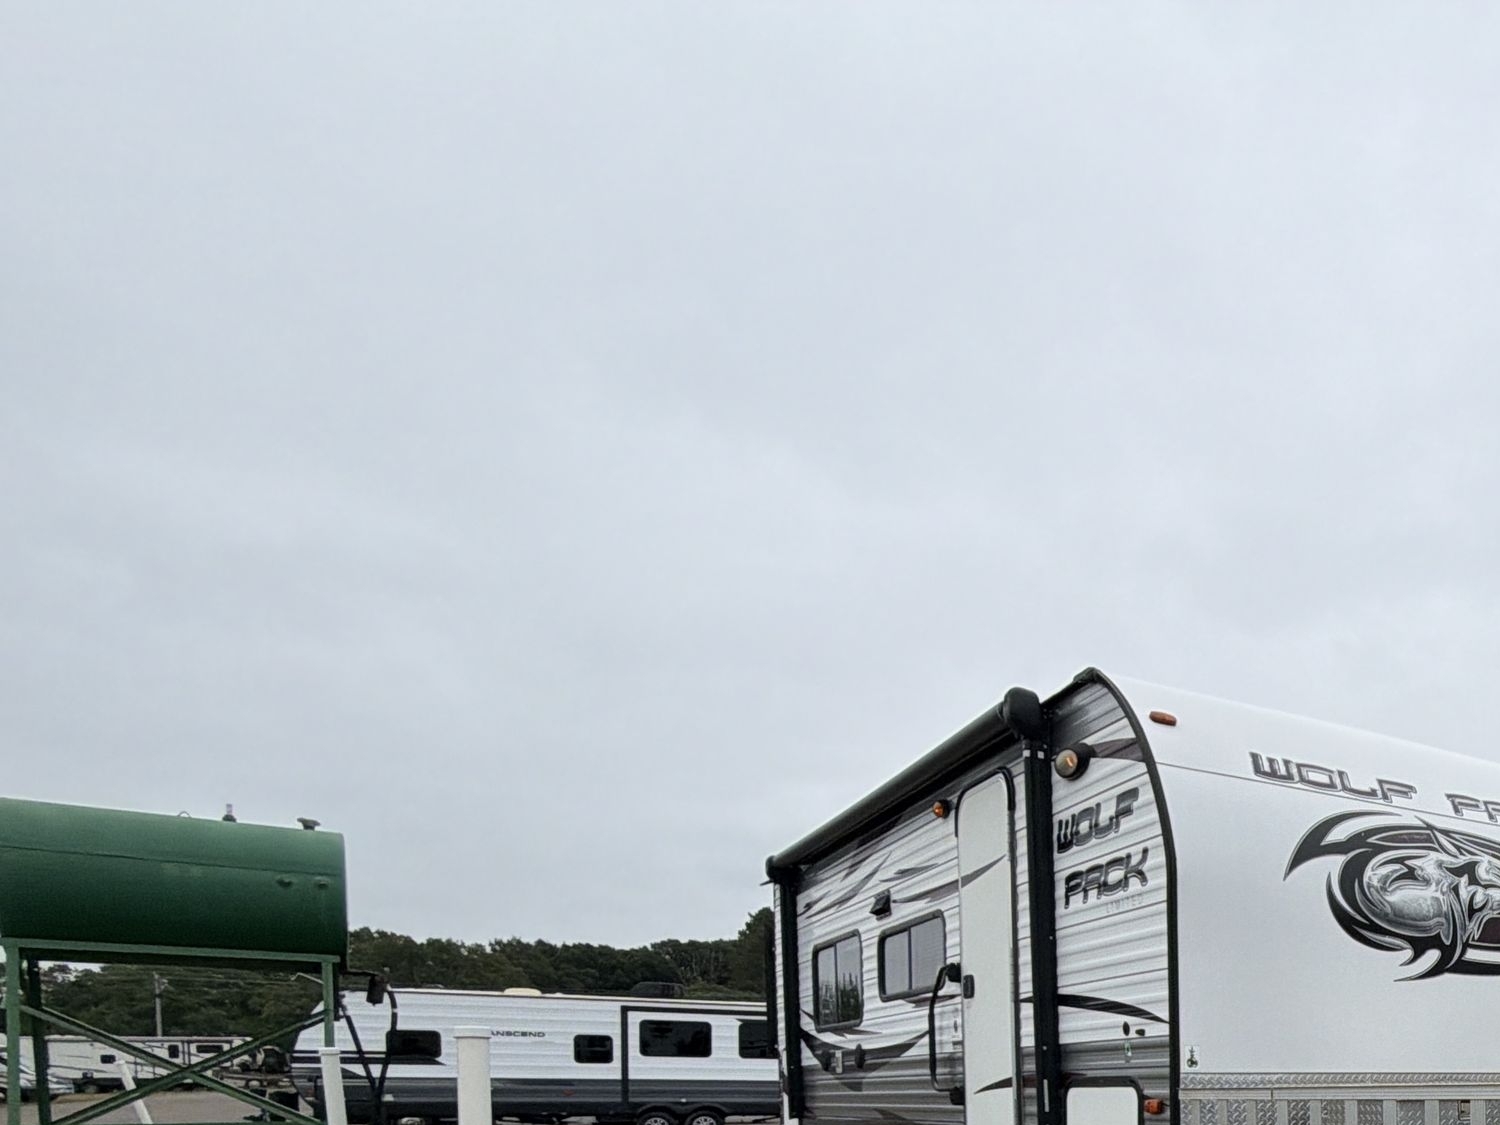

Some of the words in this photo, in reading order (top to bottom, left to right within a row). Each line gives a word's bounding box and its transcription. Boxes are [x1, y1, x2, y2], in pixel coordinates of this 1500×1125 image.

[1249, 751, 1417, 803] WOLF
[1057, 787, 1140, 854] WOLF
[1064, 846, 1149, 909] PACK
